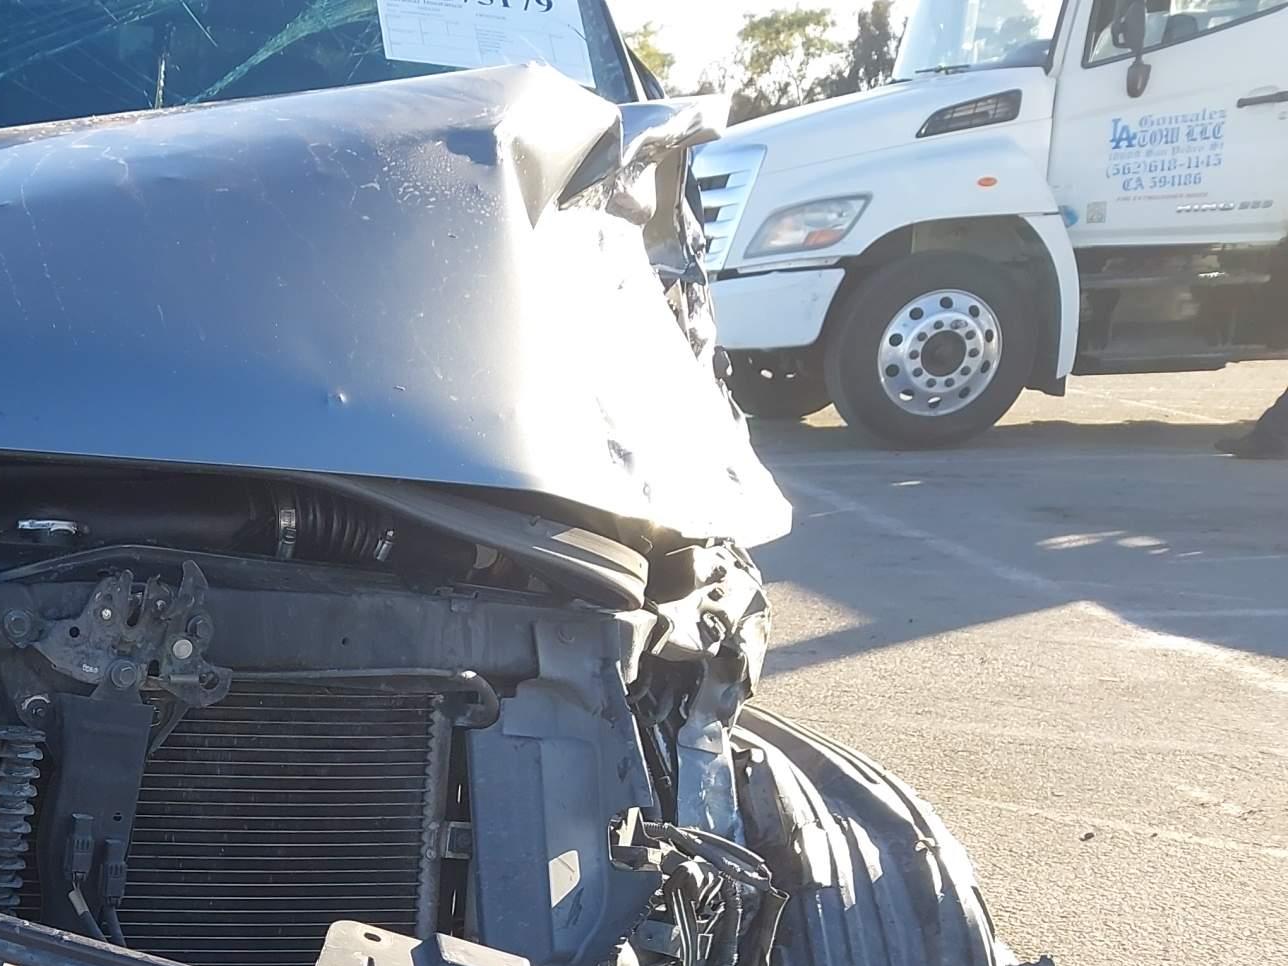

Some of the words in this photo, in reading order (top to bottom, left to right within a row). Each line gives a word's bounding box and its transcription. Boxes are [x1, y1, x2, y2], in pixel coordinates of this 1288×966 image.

[1139, 109, 1226, 127] Gonzalez
[1109, 118, 1137, 149] LA
[1137, 127, 1180, 148] TOW
[1185, 121, 1225, 142] LLC
[1122, 176, 1145, 191] CA
